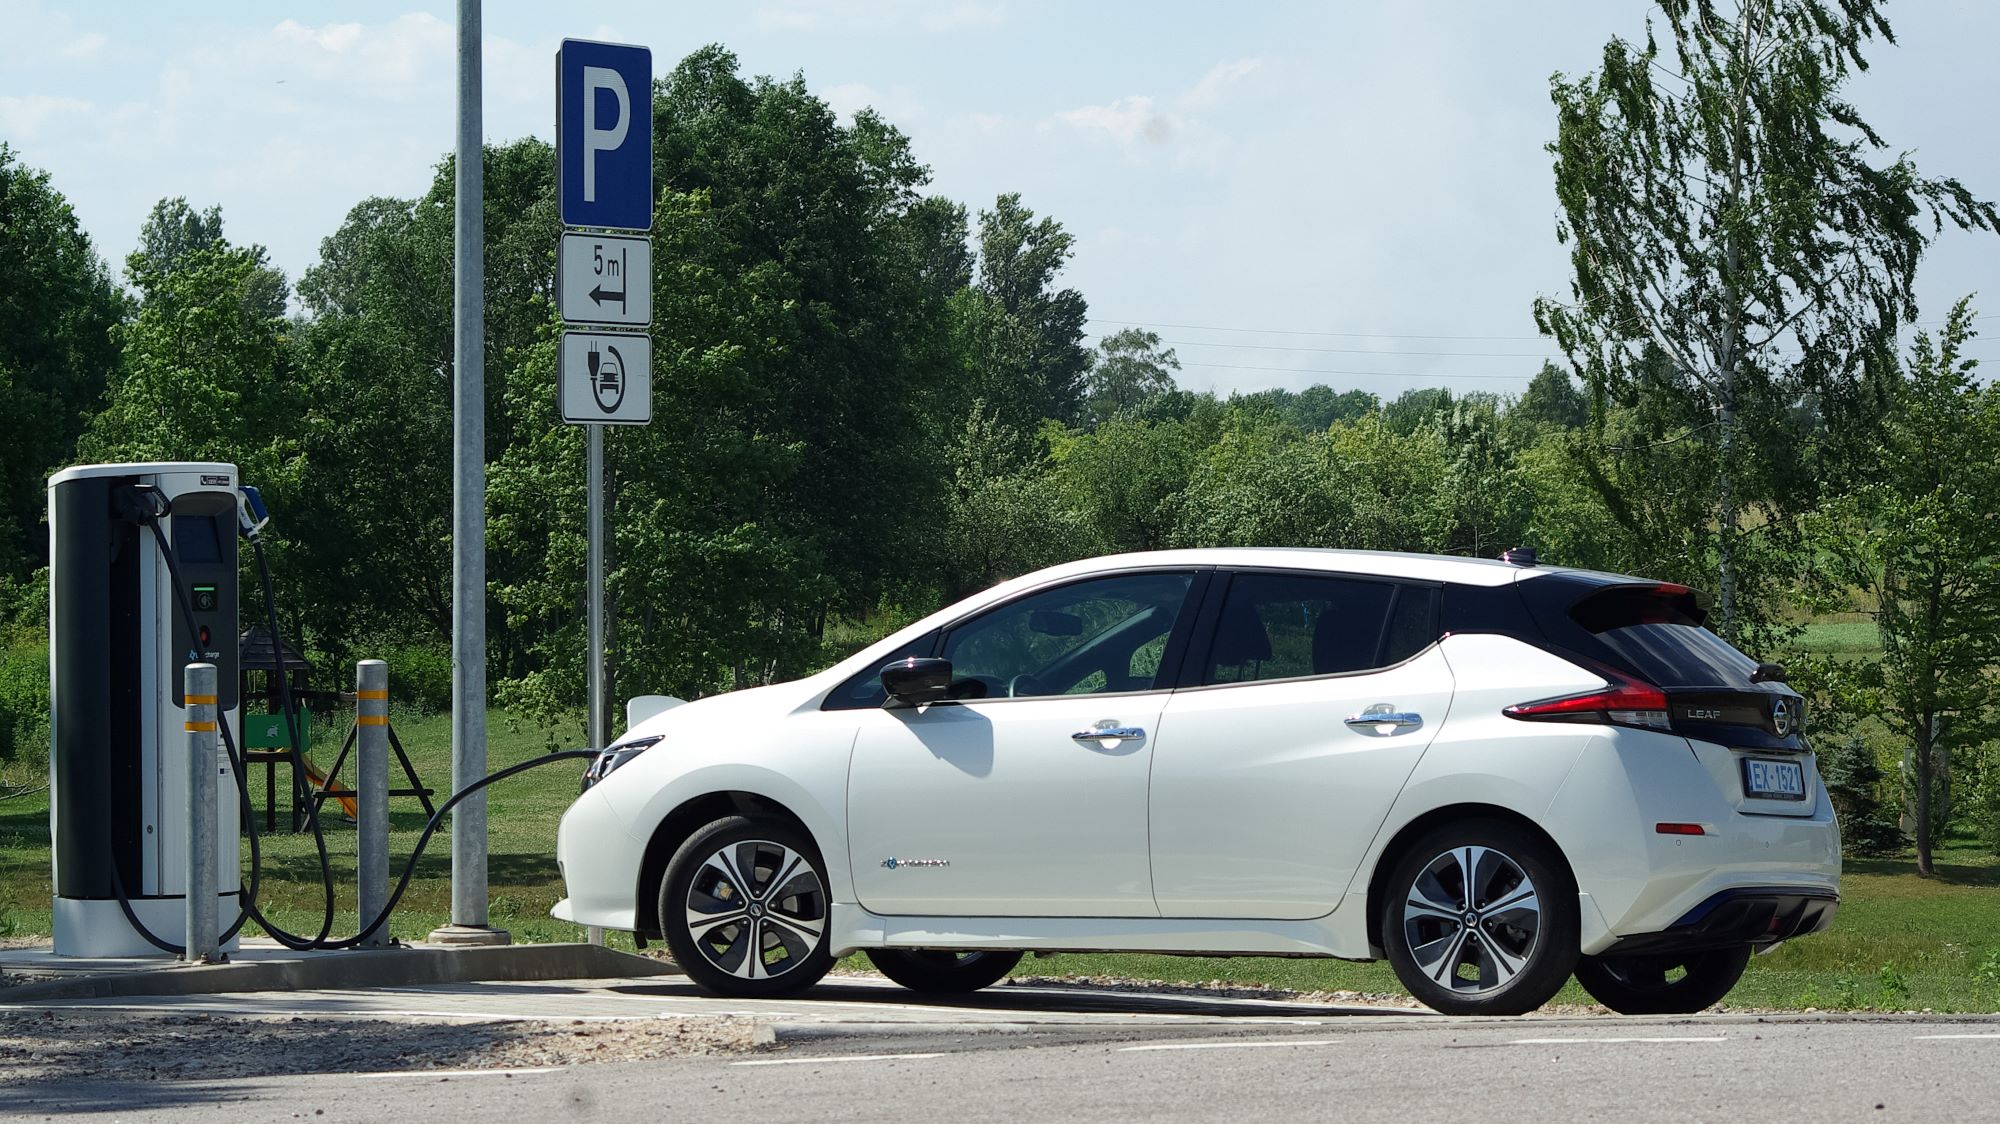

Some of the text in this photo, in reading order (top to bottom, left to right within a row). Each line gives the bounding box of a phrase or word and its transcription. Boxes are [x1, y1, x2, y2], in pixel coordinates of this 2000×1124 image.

[583, 65, 631, 202] P
[594, 245, 603, 275] 5
[1687, 709, 1721, 719] LEAF
